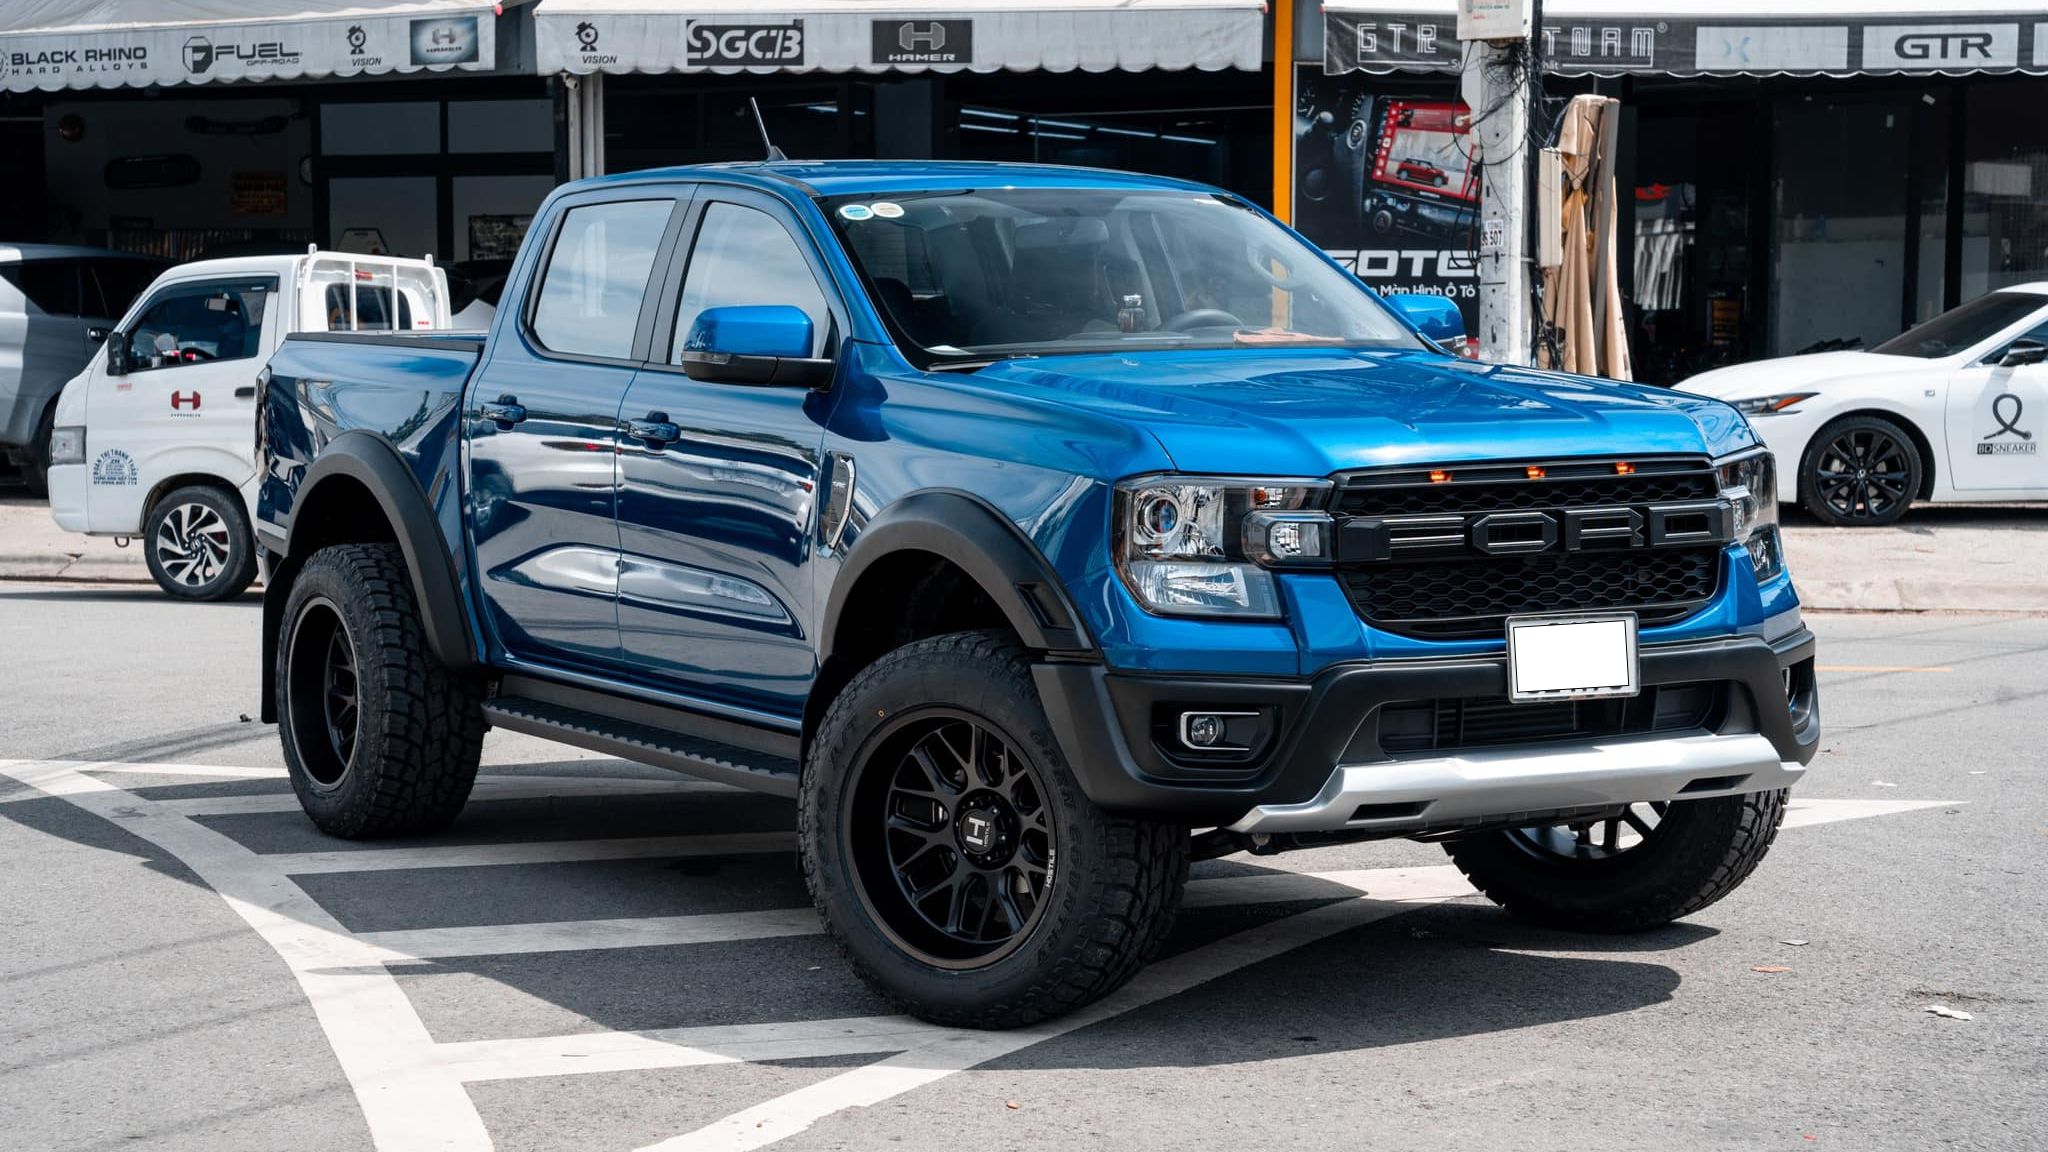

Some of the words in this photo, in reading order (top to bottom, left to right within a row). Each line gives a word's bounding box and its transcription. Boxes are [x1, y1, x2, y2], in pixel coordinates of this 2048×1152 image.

[1357, 24, 1437, 53] GTR
[1894, 33, 1993, 59] GTR
[11, 50, 77, 66] BLACK
[84, 46, 147, 62] RHINO
[215, 42, 300, 61] FUEL
[581, 54, 618, 65] VISION
[12, 66, 61, 76] HARD
[76, 62, 148, 73] ALLOYS
[246, 58, 300, 66] OFF-ROAD
[351, 57, 382, 66] VISION
[1380, 283, 1410, 296] Màn
[1445, 281, 1458, 298] Ô
[1460, 284, 1476, 298] Tô
[1337, 500, 1735, 562] FORD
[1044, 848, 1056, 889] HOSTILE
